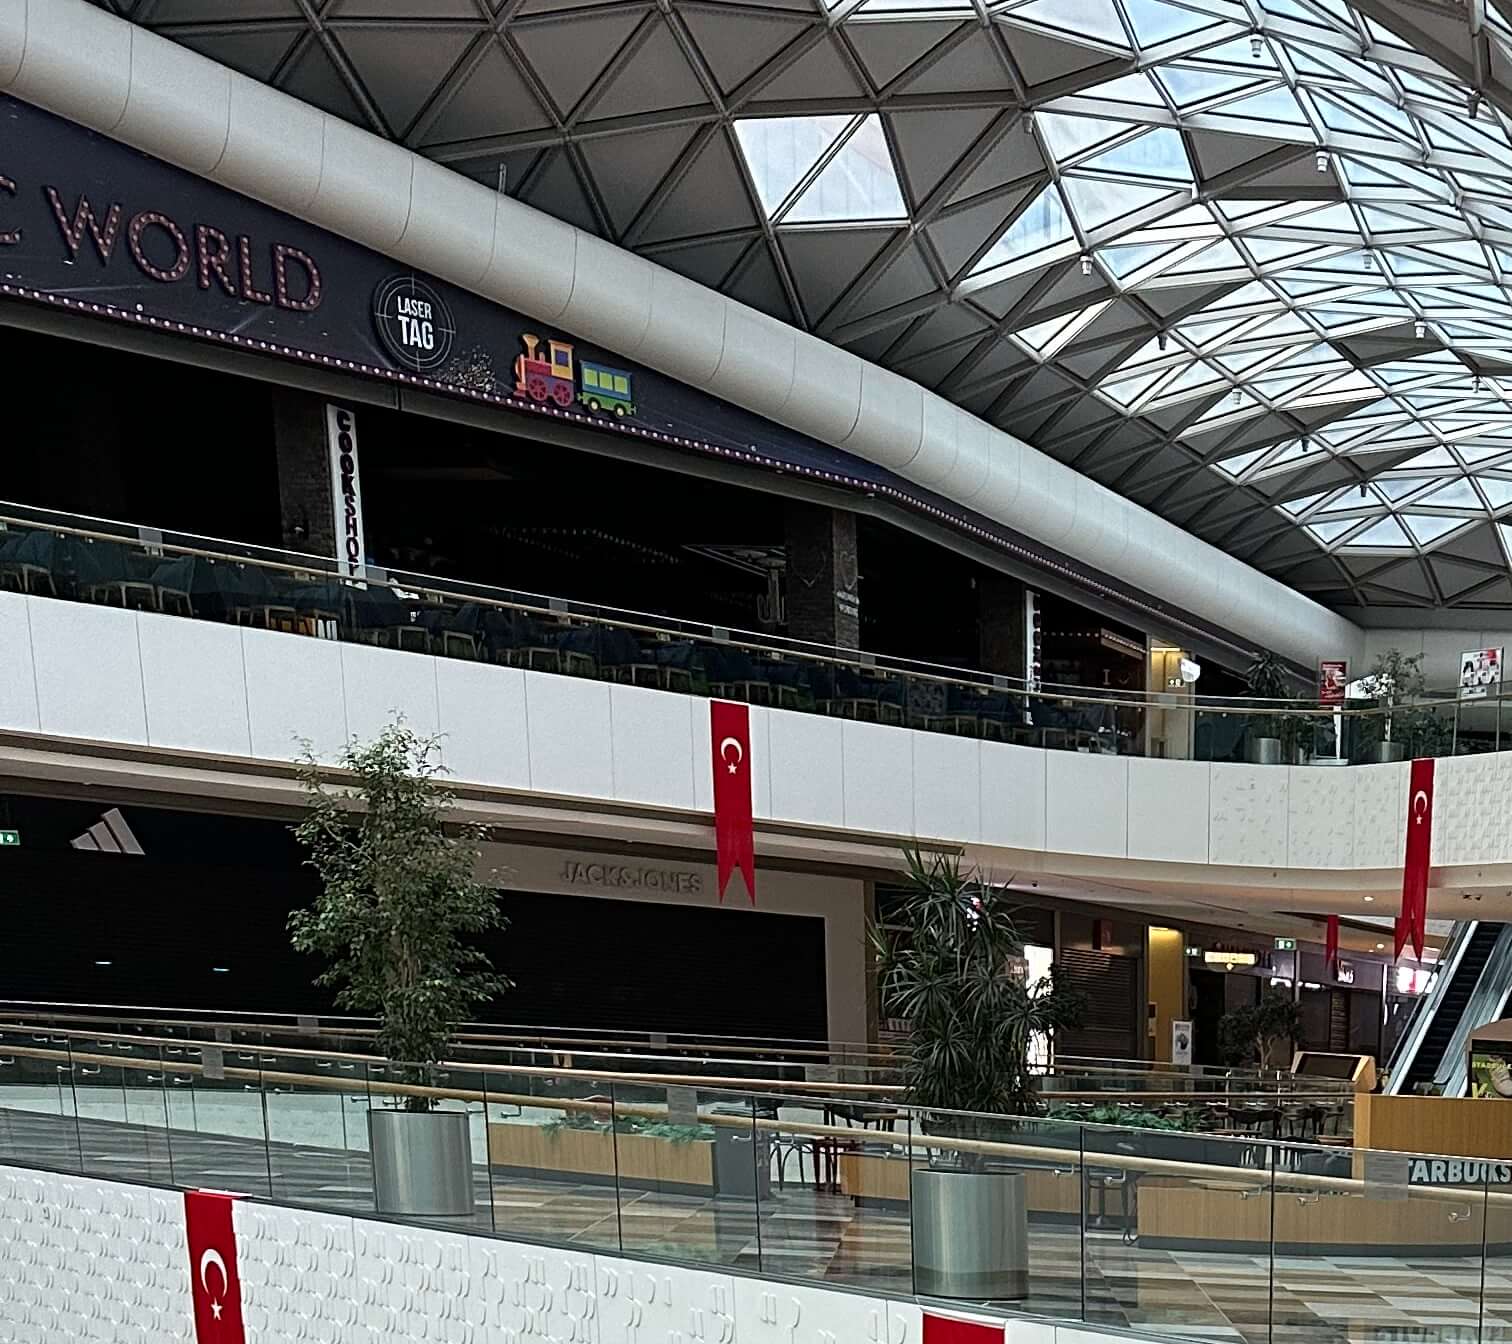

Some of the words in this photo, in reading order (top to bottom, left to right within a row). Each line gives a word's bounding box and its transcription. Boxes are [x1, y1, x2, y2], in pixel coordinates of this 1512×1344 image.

[47, 185, 322, 312] WORLD
[397, 295, 432, 320] LASER
[397, 314, 434, 350] TAG
[1408, 1160, 1511, 1184] ARBUCKS
